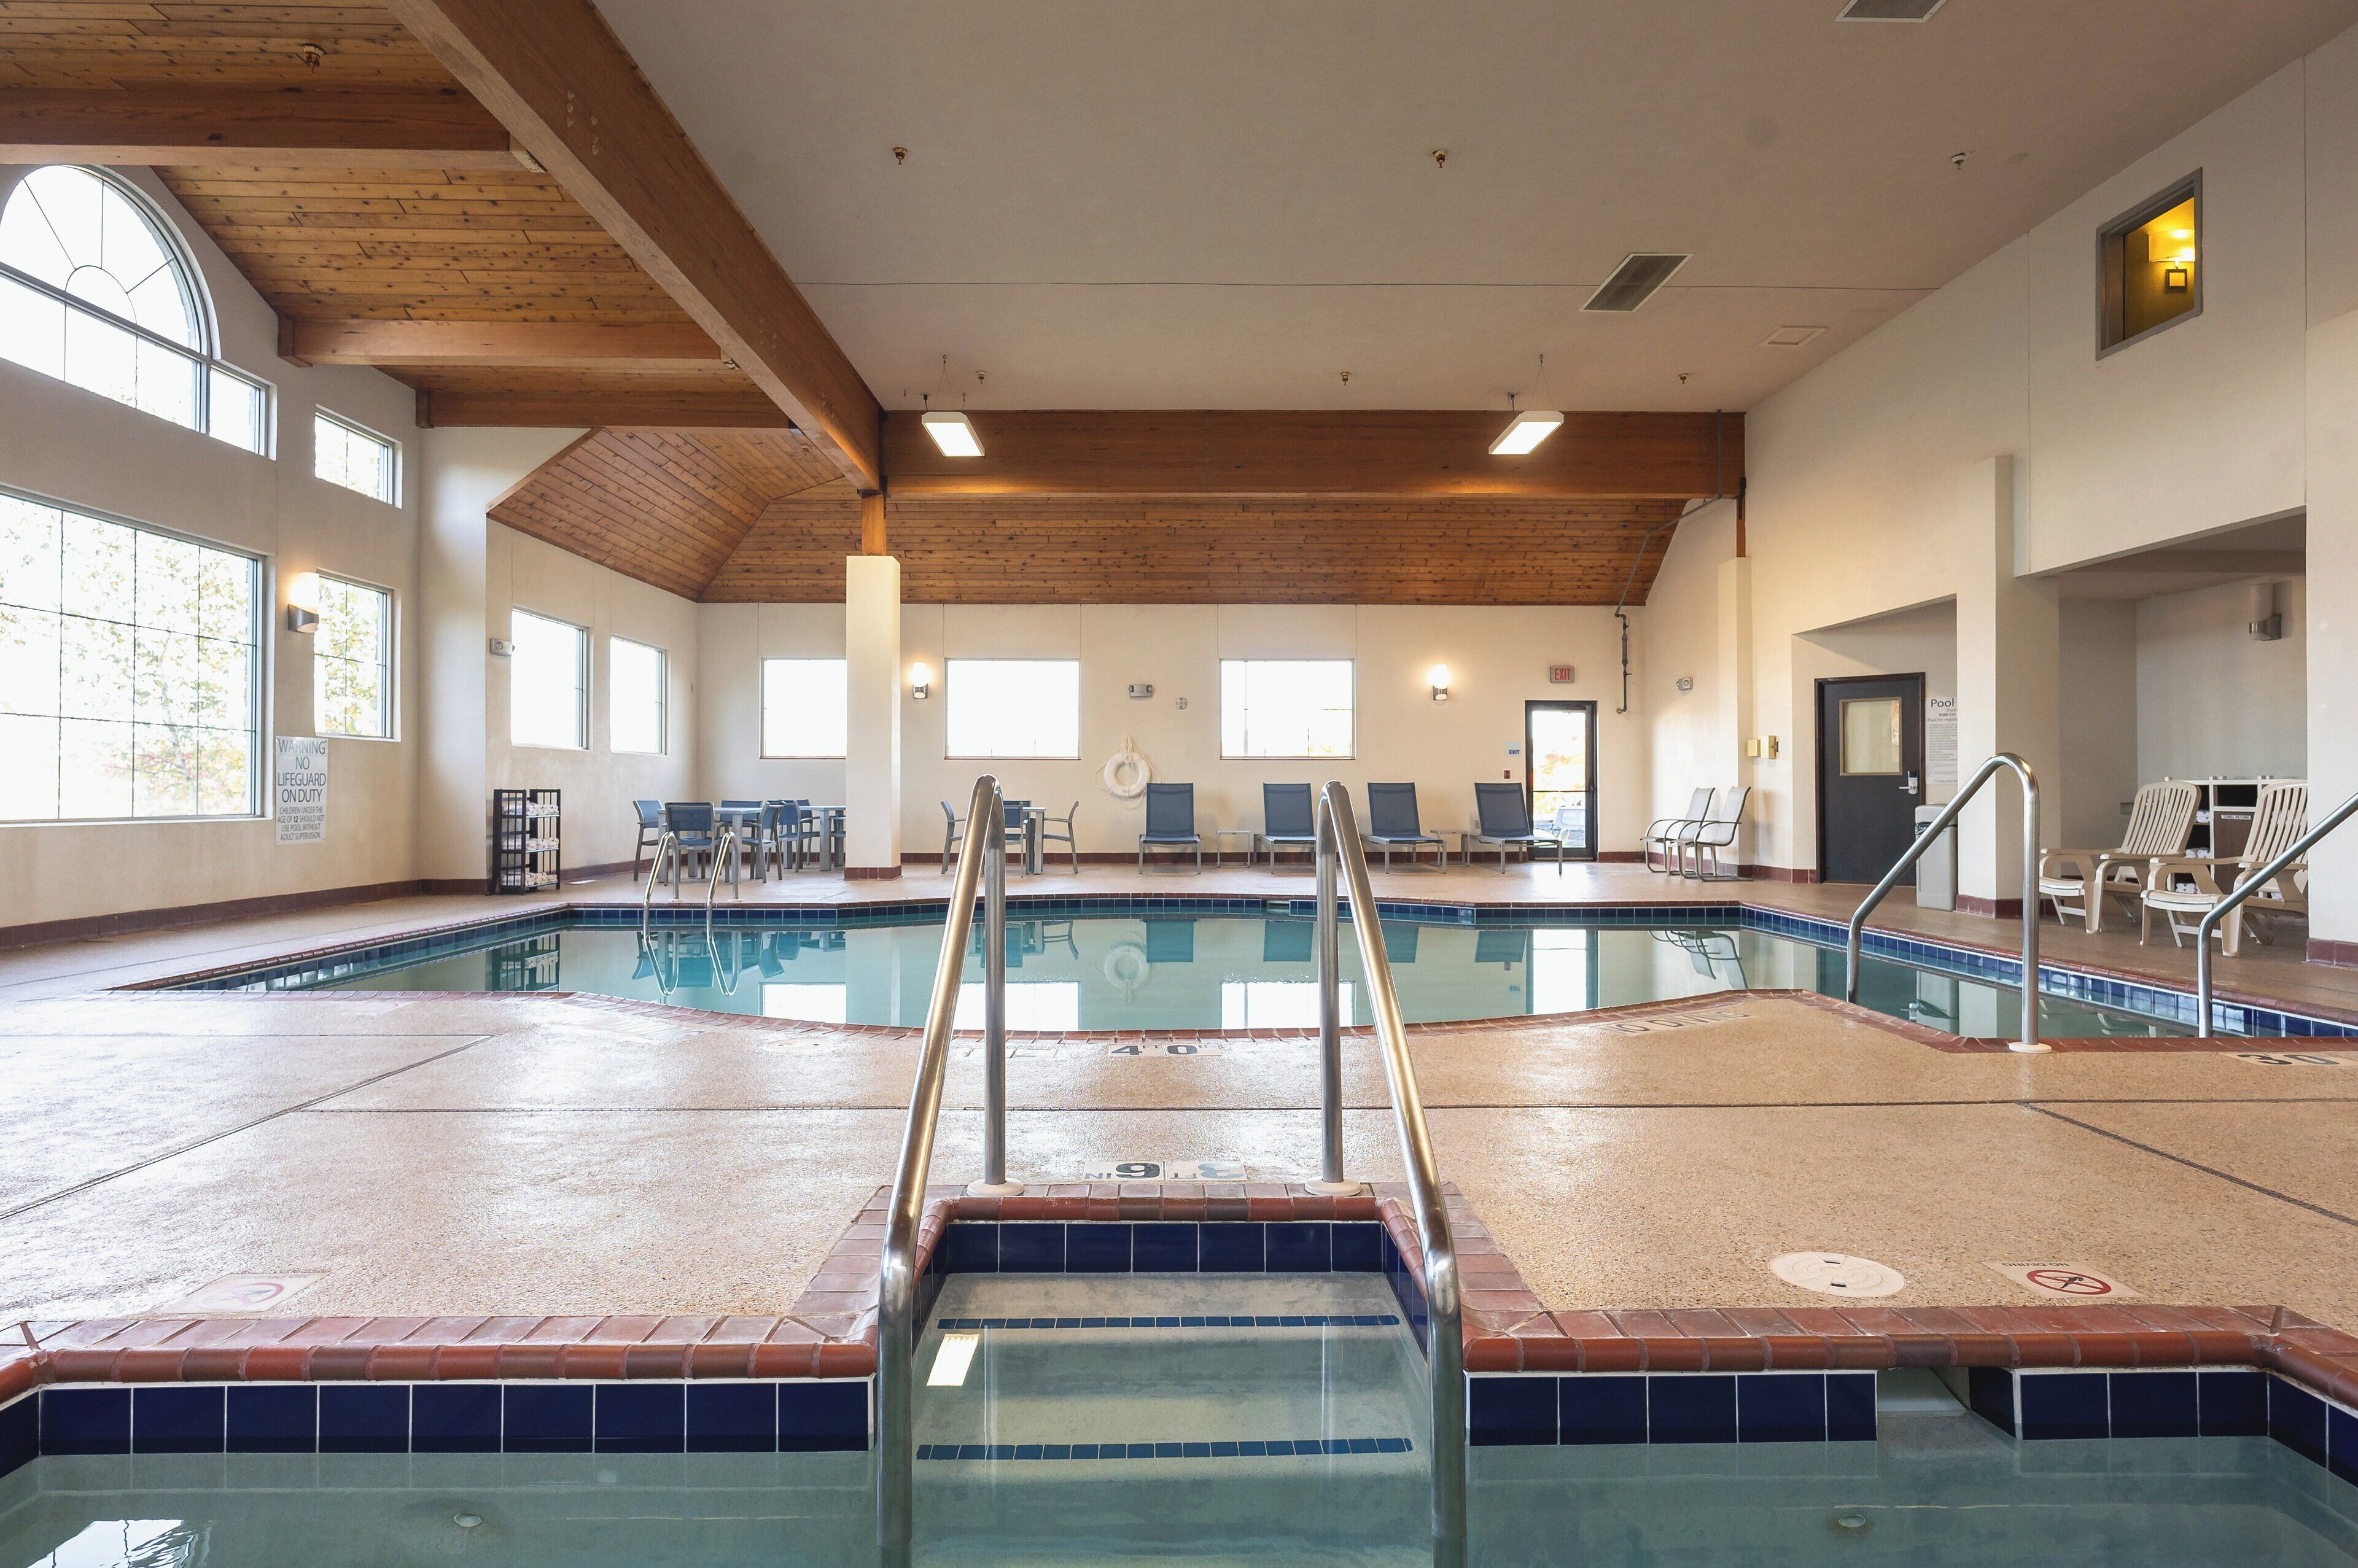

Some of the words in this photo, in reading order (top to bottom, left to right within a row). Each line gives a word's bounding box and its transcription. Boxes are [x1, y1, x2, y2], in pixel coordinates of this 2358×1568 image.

[1555, 668, 1571, 680] EXIT
[1931, 698, 1954, 707] Pool
[278, 739, 325, 755] WARNING
[295, 756, 310, 770] NO
[278, 772, 326, 786] LIFEGUARD
[282, 789, 297, 802] ON
[298, 789, 322, 802] DUTY
[1599, 1024, 1650, 1034] NO
[1645, 1011, 1749, 1028] DIVING
[1111, 1046, 1142, 1055] 4
[1167, 1045, 1197, 1055] 0
[2236, 1054, 2292, 1065] 3
[2283, 1054, 2340, 1065] 0
[1198, 1162, 1243, 1179] 3
